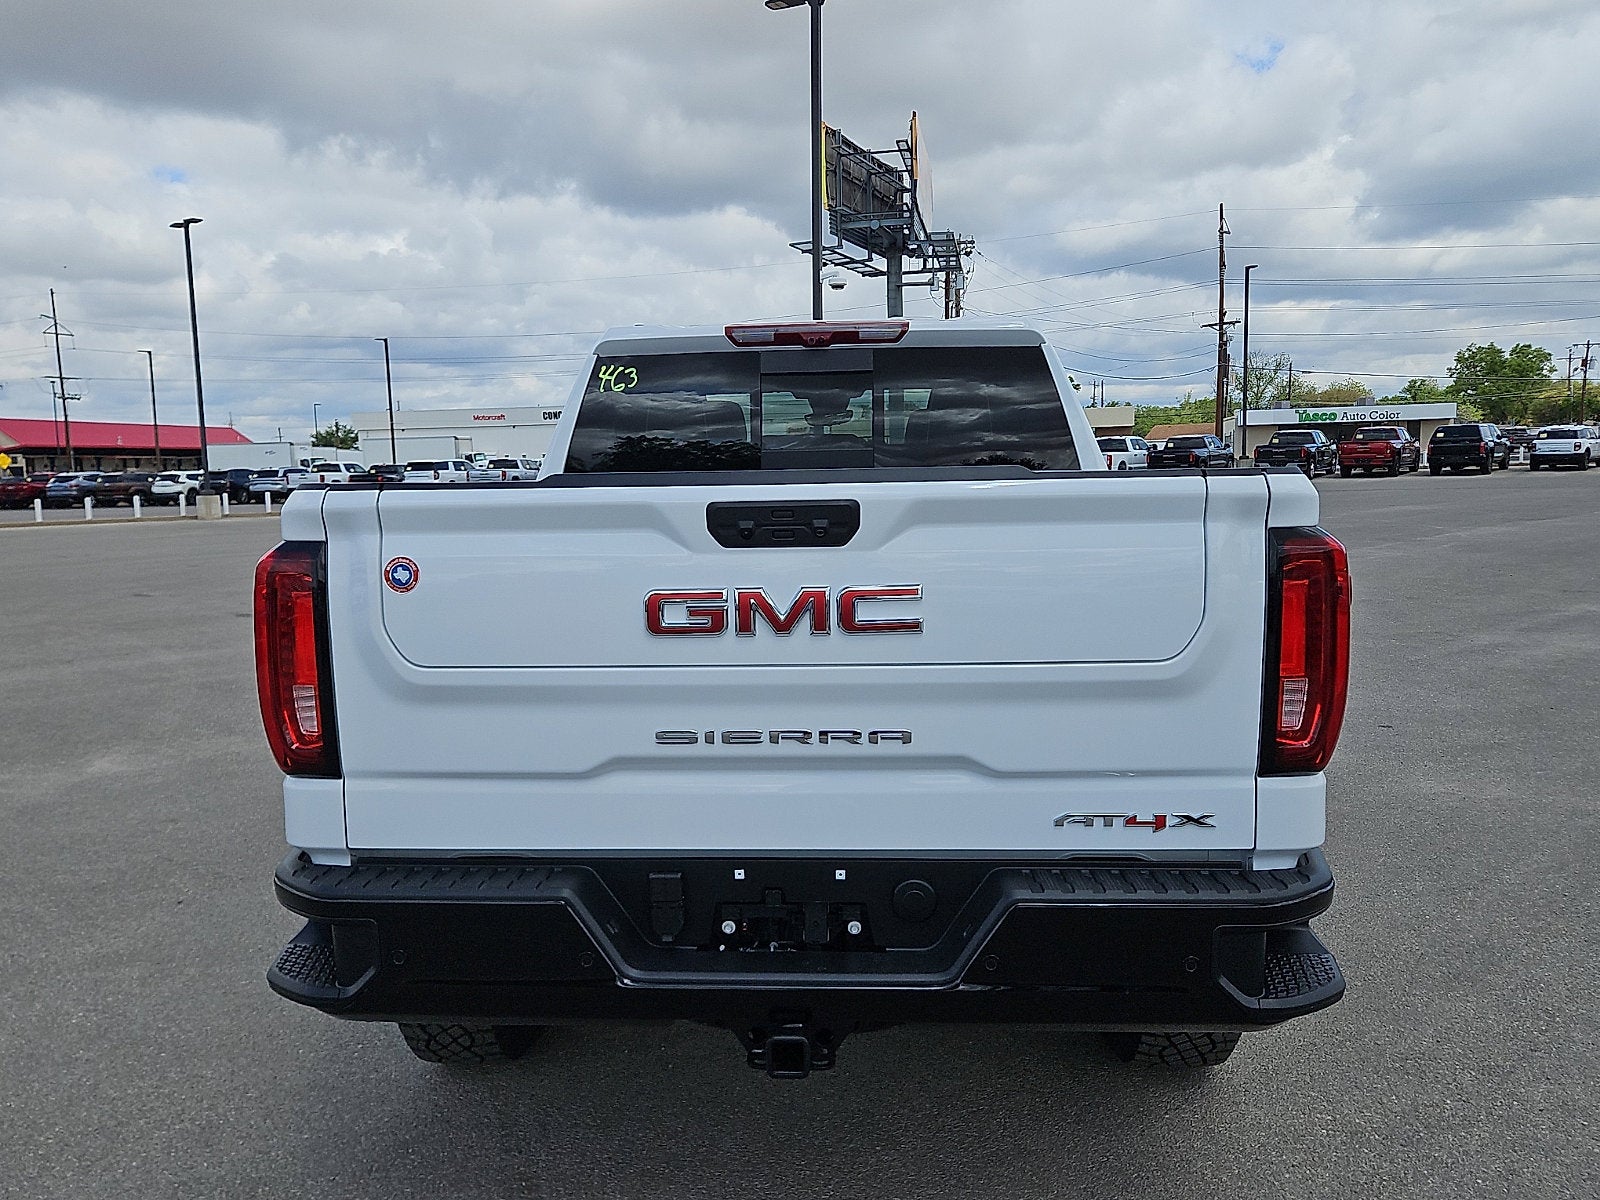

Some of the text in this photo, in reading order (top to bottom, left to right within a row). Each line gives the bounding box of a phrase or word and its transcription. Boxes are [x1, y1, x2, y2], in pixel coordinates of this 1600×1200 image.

[598, 364, 638, 392] 463
[472, 413, 506, 421] Motorcraft
[1294, 410, 1401, 422] TASCO Auto Color
[644, 583, 923, 637] GMC
[655, 728, 912, 745] SIERRA
[1053, 812, 1217, 833] AT4X
